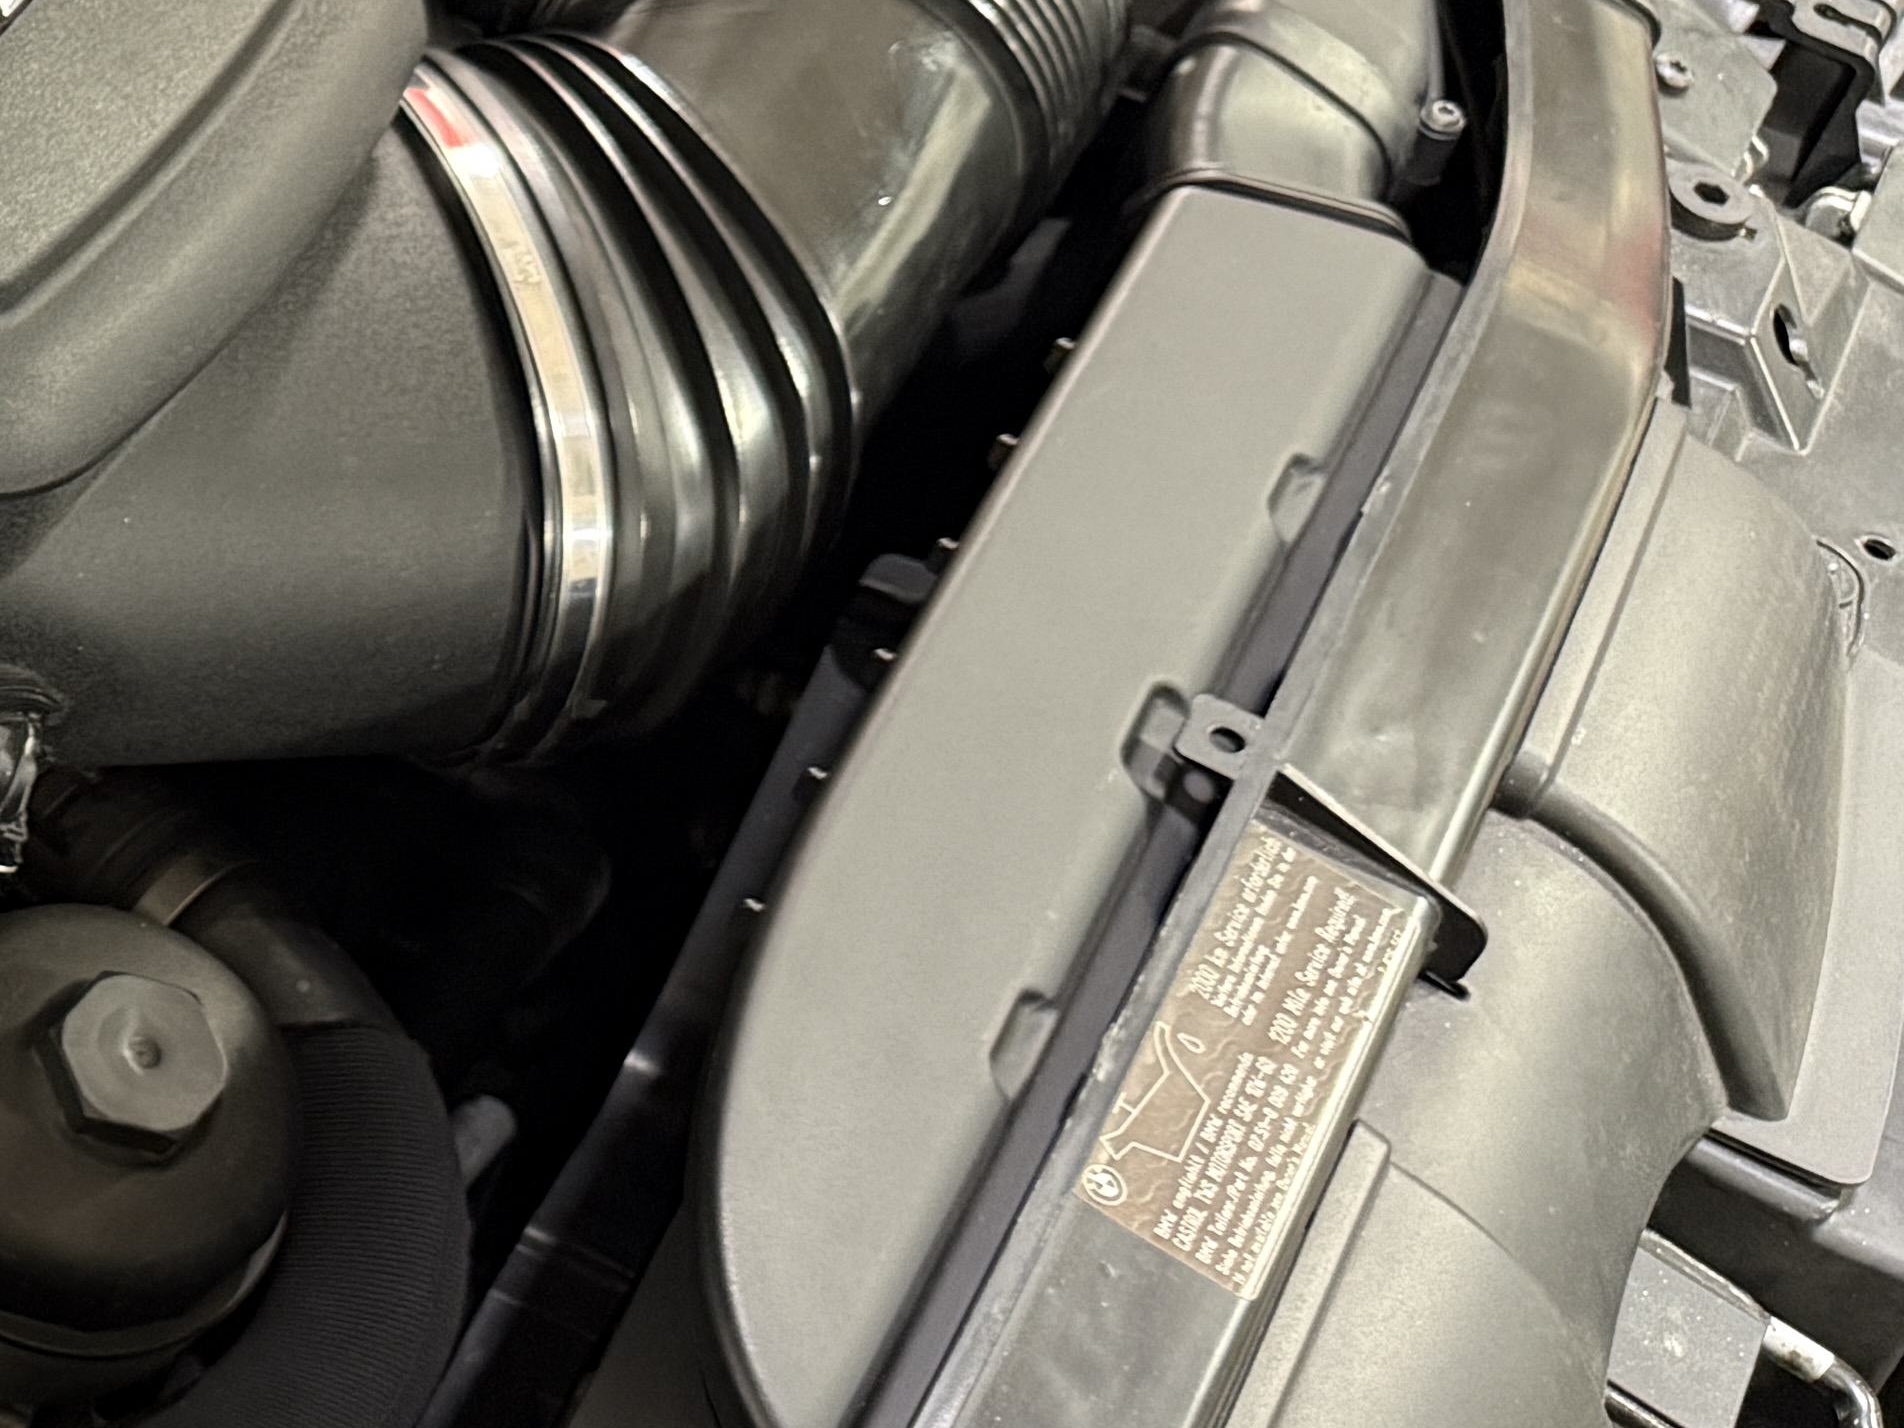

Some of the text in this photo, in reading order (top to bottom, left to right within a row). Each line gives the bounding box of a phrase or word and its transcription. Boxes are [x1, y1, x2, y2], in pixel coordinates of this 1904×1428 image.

[1219, 903, 1251, 947] Service
[1294, 943, 1332, 987] Service
[1281, 987, 1312, 1017] Mile
[1268, 1012, 1299, 1045] 1200
[1152, 1208, 1179, 1240] BMW
[1199, 1113, 1224, 1143] BMW
[1216, 1052, 1254, 1115] recommends
[1171, 1206, 1209, 1252] CASTROL
[1204, 1118, 1247, 1183] MOTORSPORT
[1194, 1235, 1219, 1265] BMW
